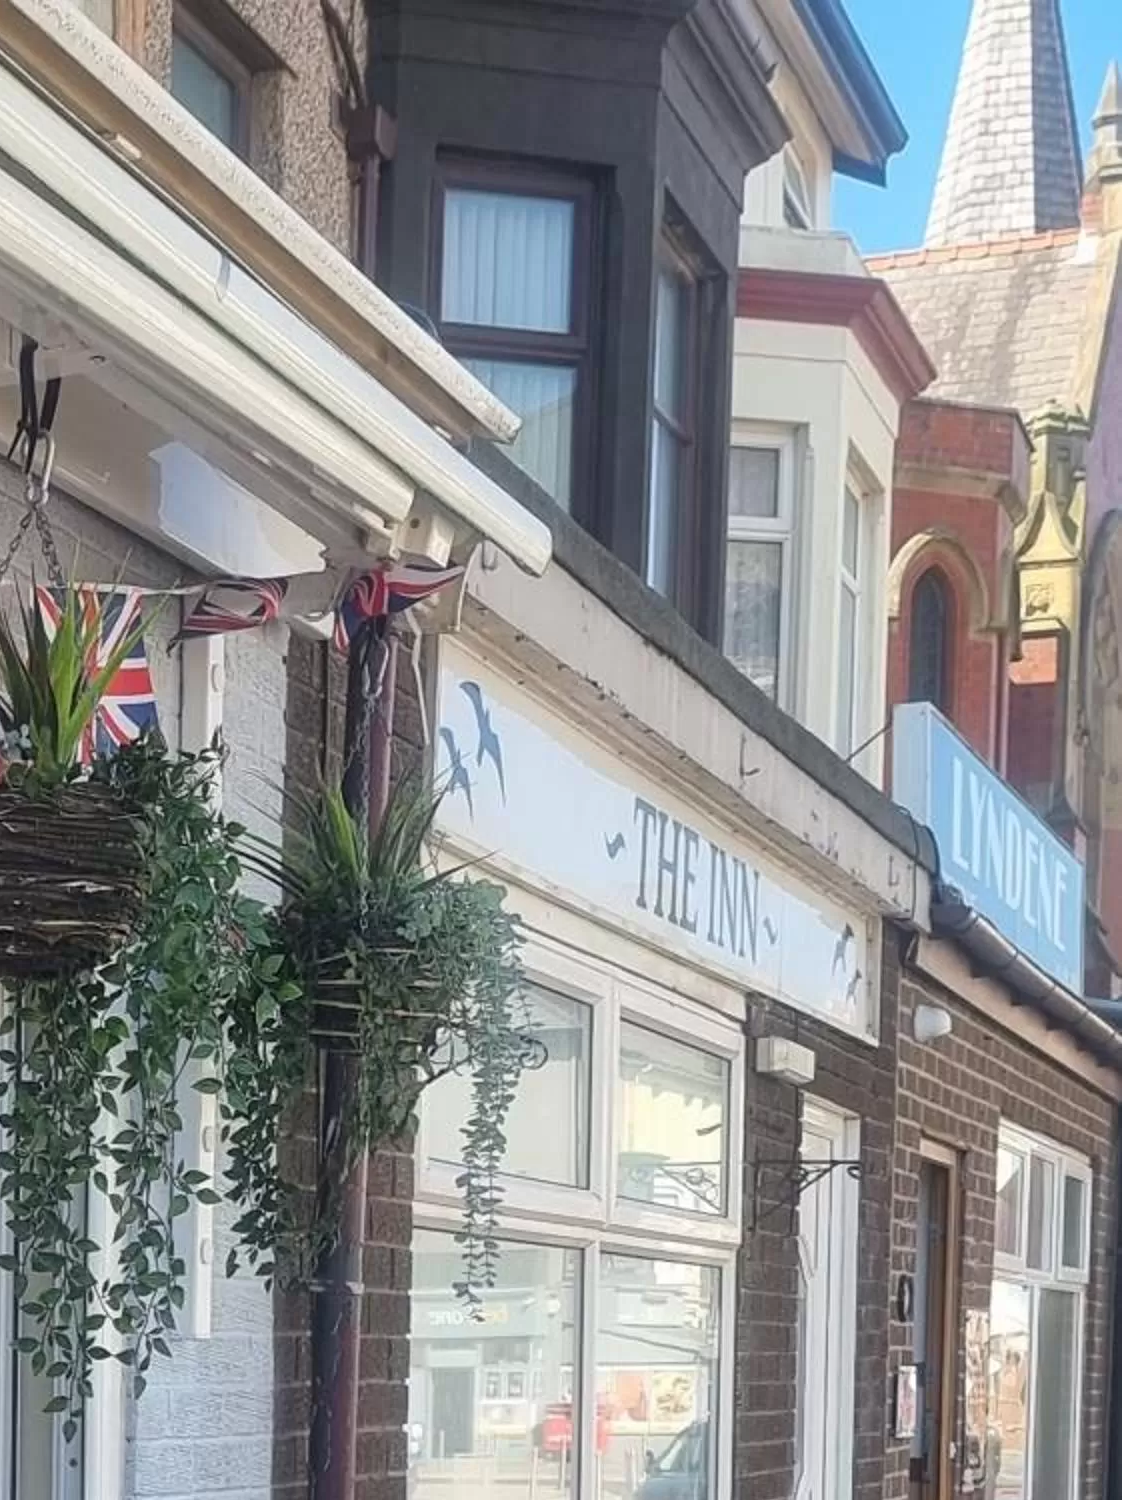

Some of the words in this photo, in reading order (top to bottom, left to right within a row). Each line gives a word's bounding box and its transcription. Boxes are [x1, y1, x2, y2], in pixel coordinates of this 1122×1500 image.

[634, 797, 699, 936] THE
[707, 841, 761, 964] INN
[953, 756, 1068, 951] LYNDENE
